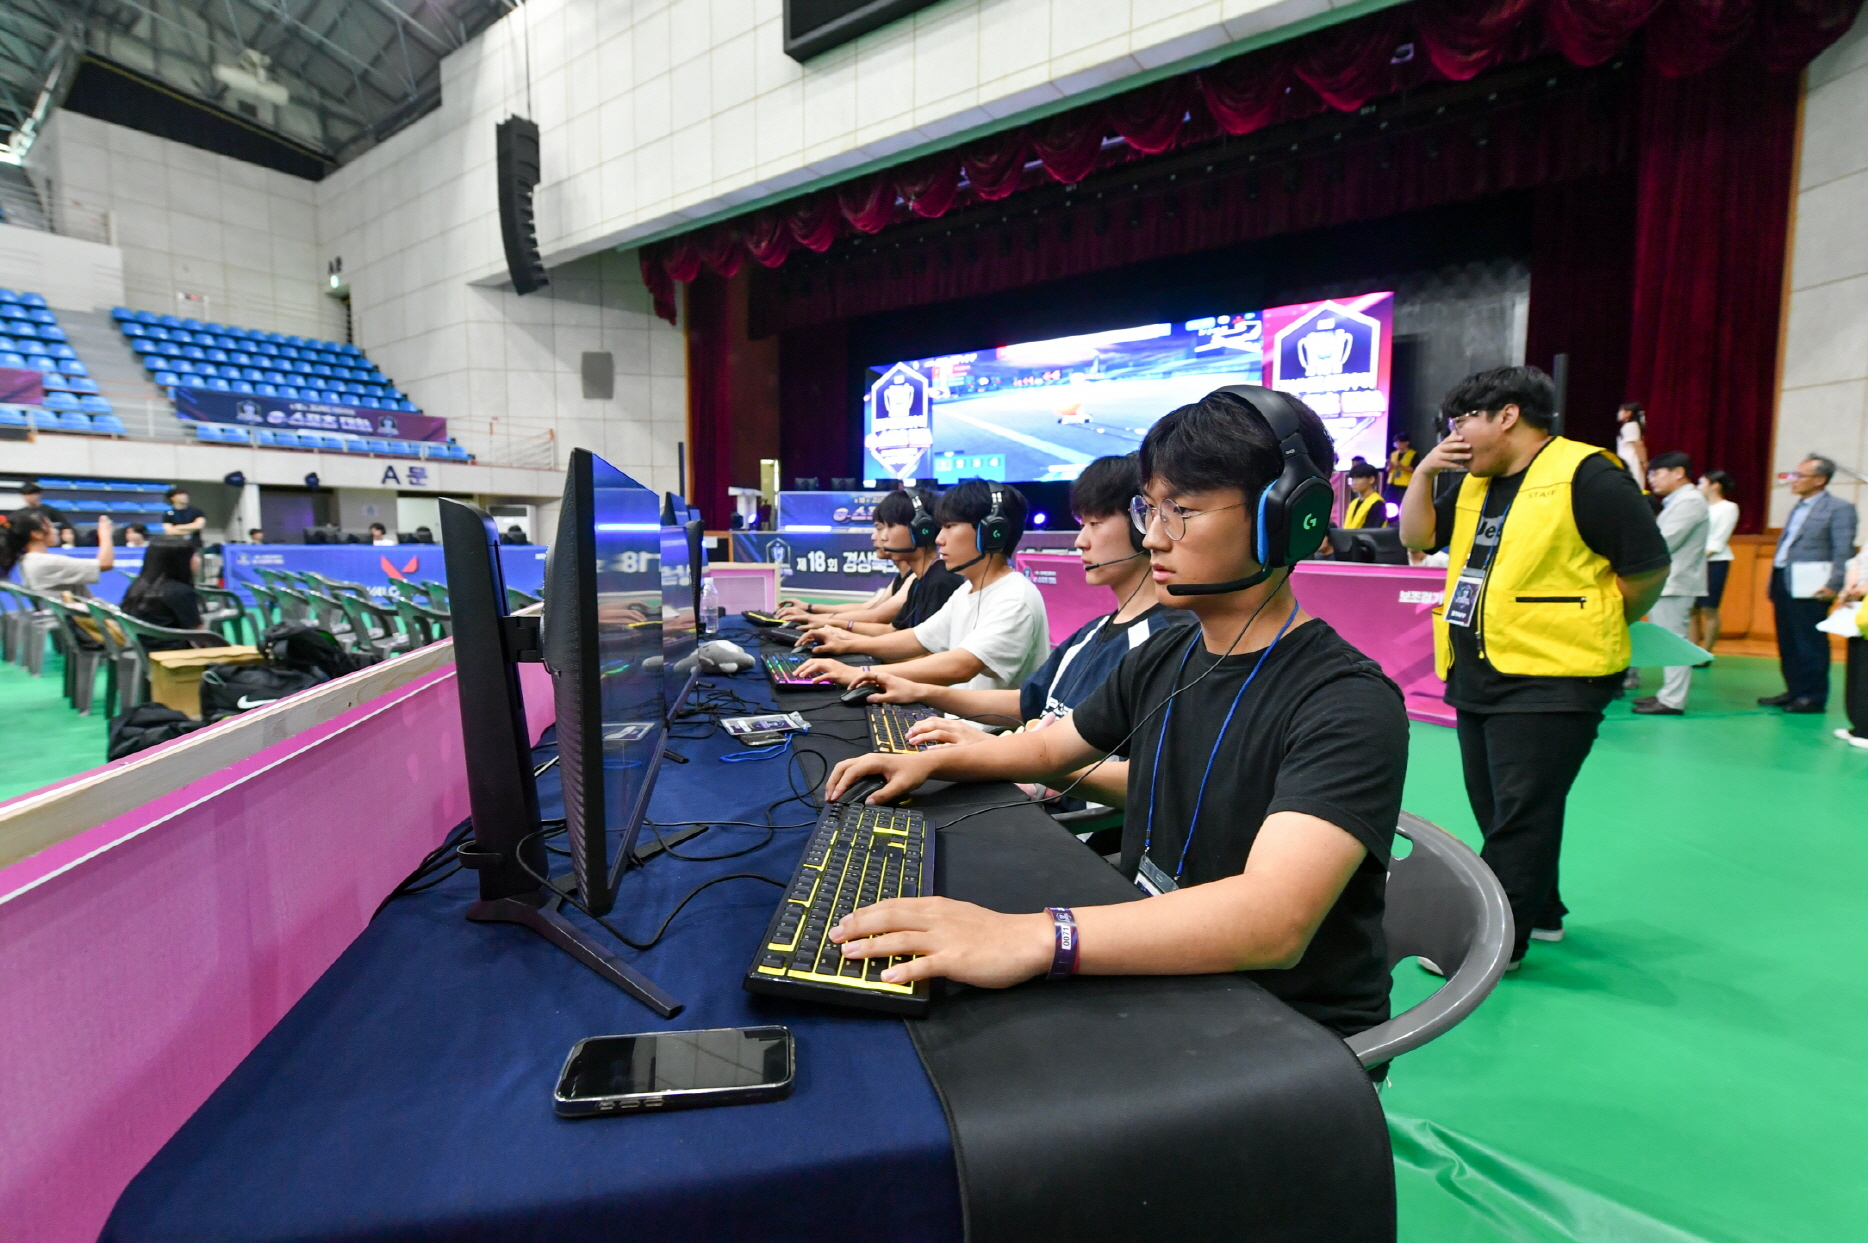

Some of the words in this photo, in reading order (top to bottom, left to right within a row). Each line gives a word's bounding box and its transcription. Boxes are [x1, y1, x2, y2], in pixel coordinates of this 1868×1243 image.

[381, 465, 401, 485] A
[406, 466, 428, 486] 문
[796, 550, 839, 573] 제18회
[843, 551, 900, 574] 경상북
[1062, 927, 1070, 947] 0071
